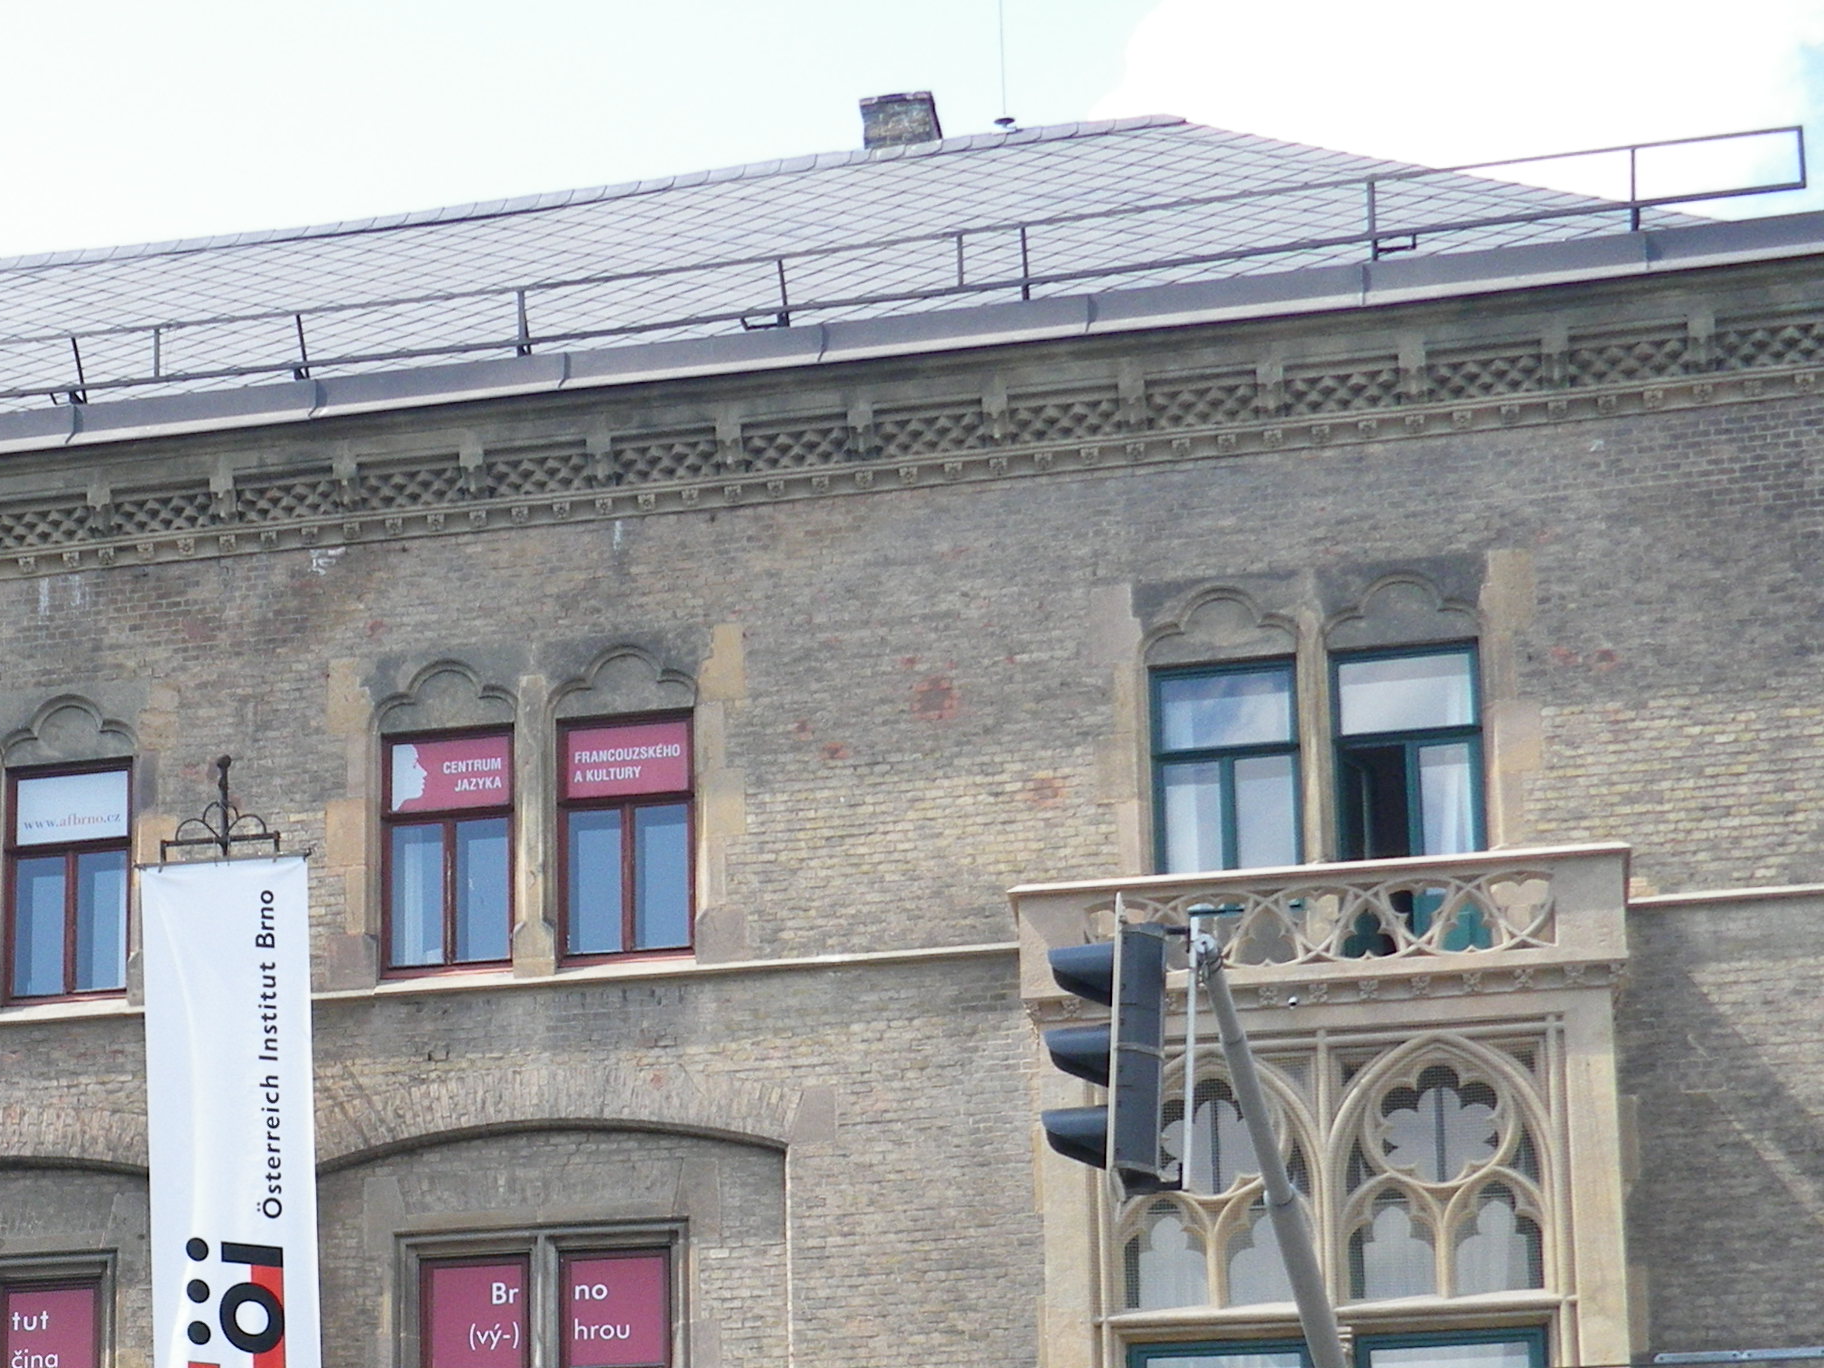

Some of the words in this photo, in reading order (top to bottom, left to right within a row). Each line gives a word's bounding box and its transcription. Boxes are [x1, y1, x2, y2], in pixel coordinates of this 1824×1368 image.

[575, 743, 681, 765] FRANCOUZSKÉHO
[443, 757, 502, 775] CENTRUM
[574, 770, 583, 783] A
[586, 766, 642, 782] KULTURY
[454, 776, 502, 792] JAZYKA
[23, 811, 121, 832] www.afbrno.cz
[255, 889, 276, 949] Brno
[257, 961, 279, 1062] Institut
[256, 1074, 283, 1220] Österreich
[491, 1282, 520, 1305] Br
[574, 1282, 608, 1301] no
[11, 1310, 50, 1331] tut
[469, 1321, 520, 1351] (vý-)
[574, 1318, 631, 1341] hrou
